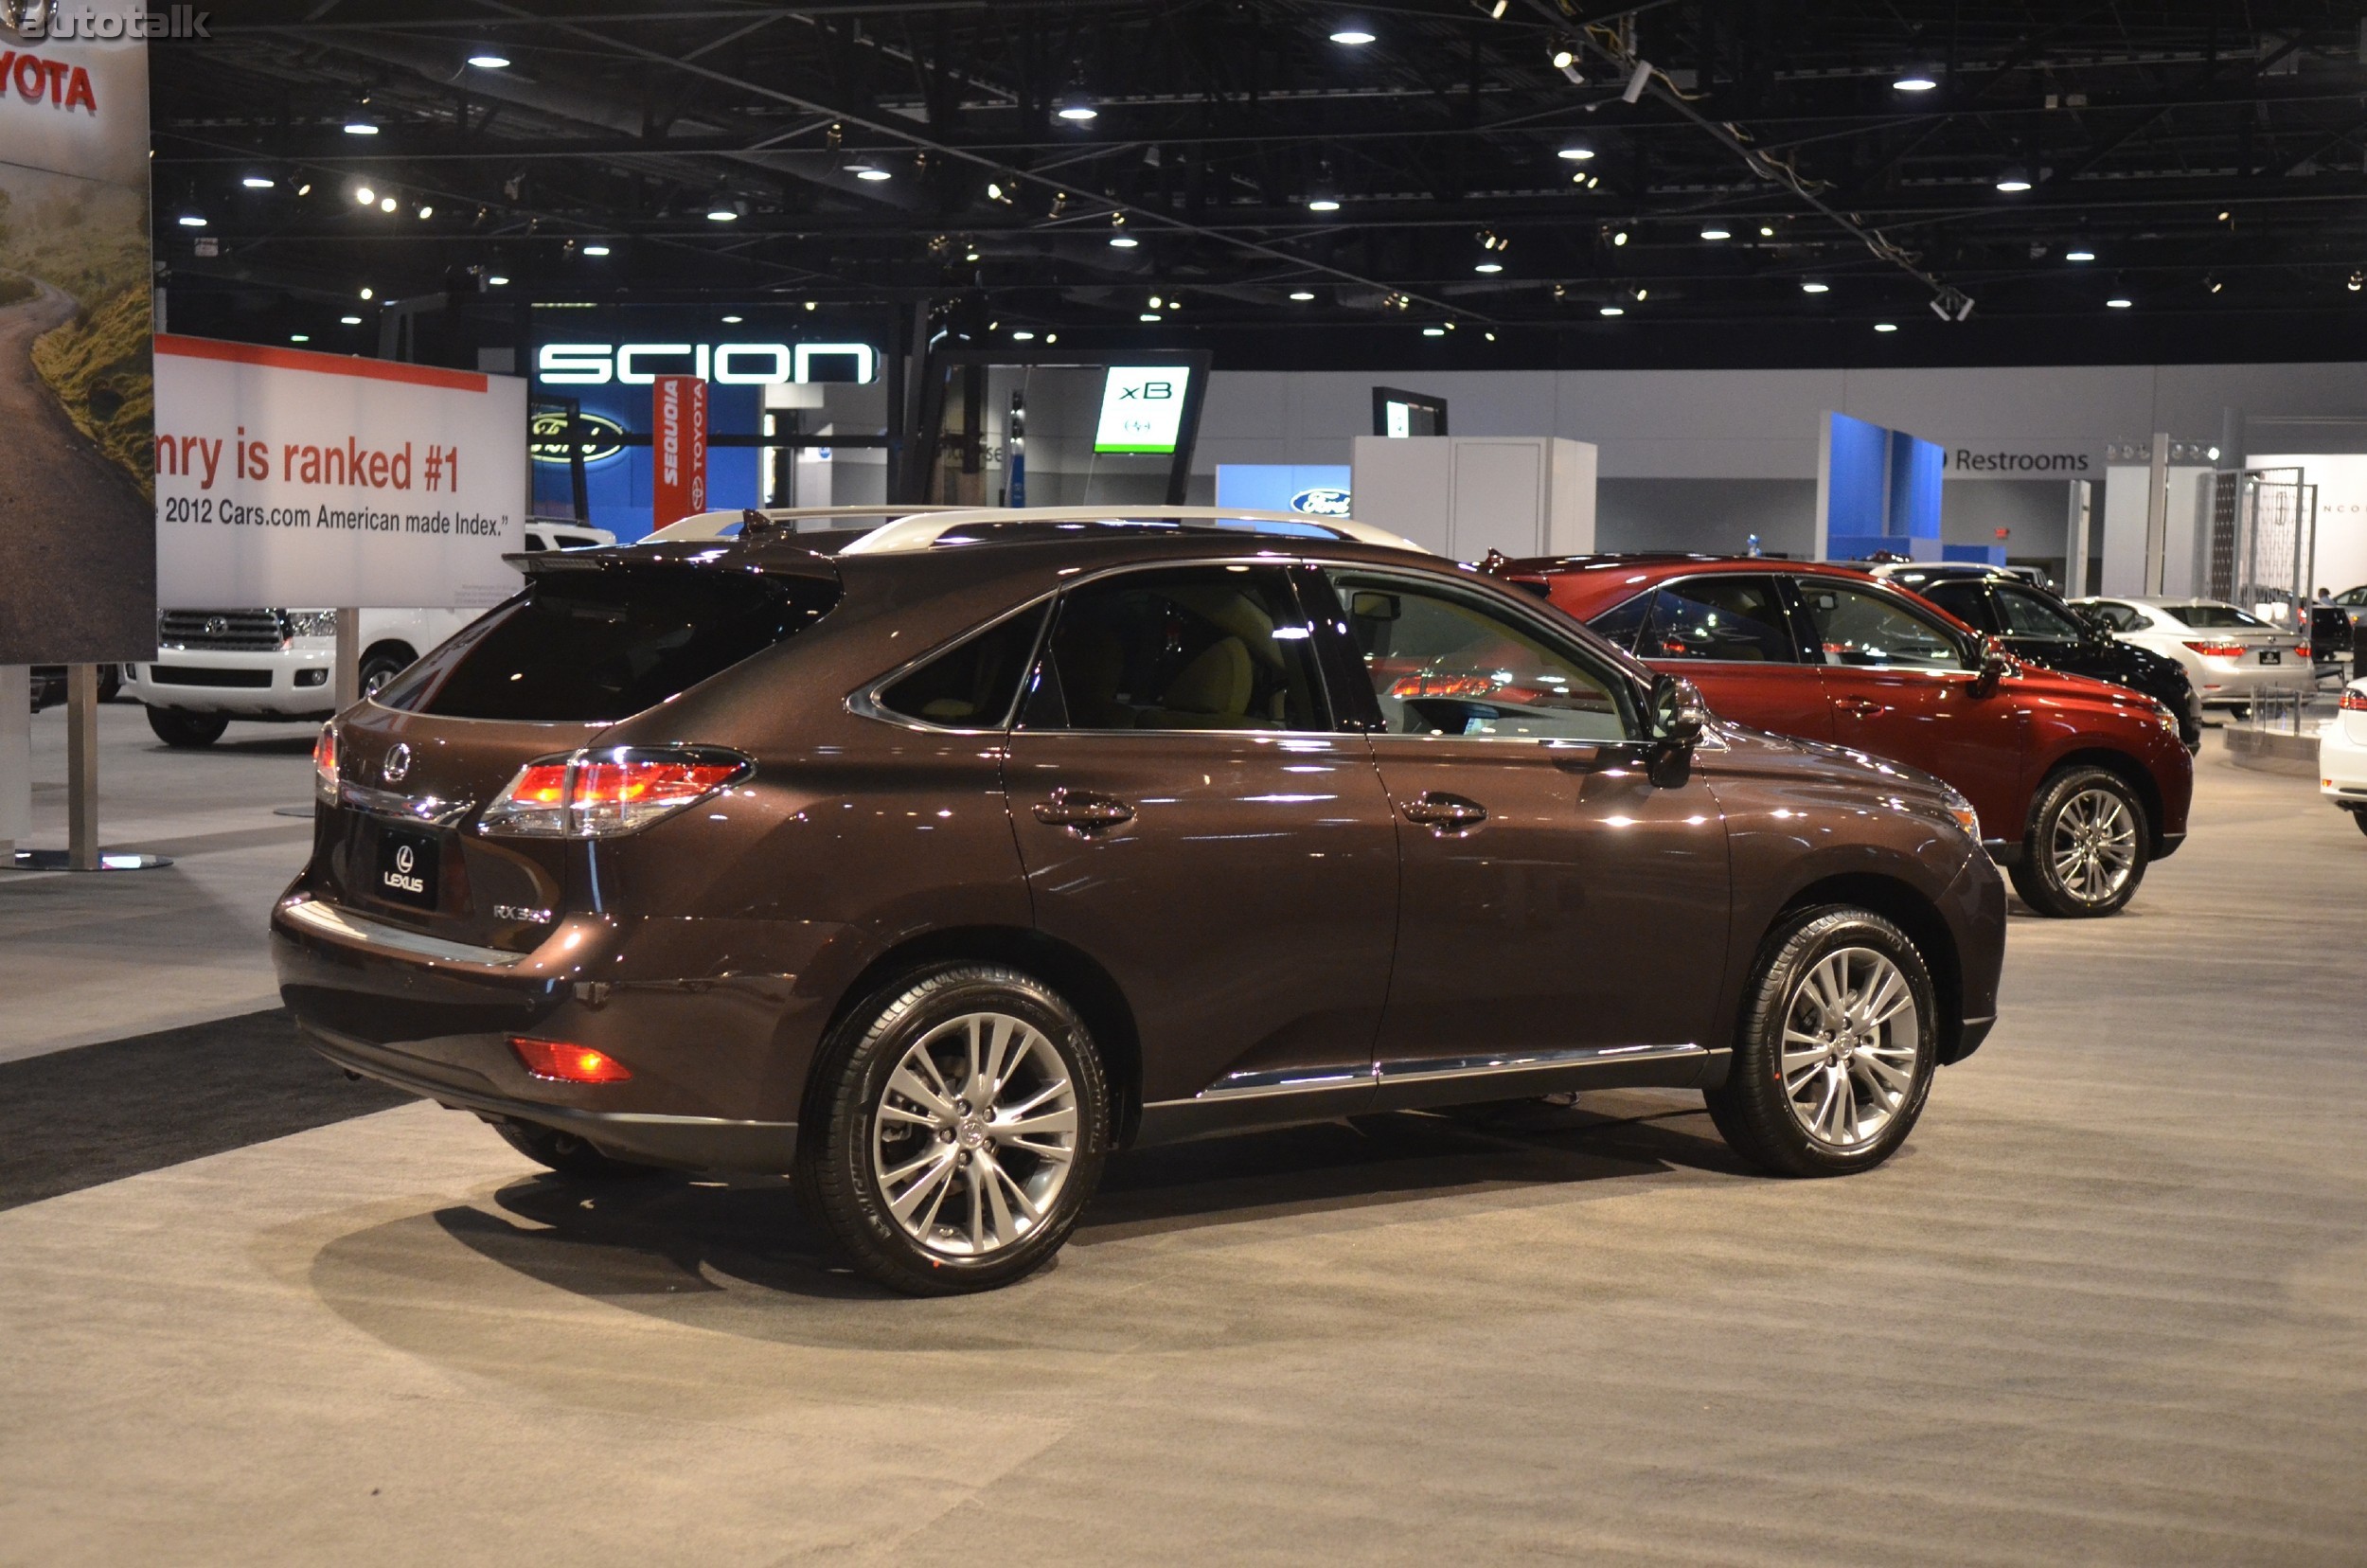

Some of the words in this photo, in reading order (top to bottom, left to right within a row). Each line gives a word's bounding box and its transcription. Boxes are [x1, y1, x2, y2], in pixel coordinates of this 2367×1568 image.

[1119, 383, 1172, 400] xB
[665, 381, 678, 486] SEQUOIA
[694, 383, 703, 472] TOYOTA
[238, 426, 269, 481] is
[284, 436, 411, 490] ranked
[425, 445, 457, 492] #1
[1956, 449, 2089, 471] Restrooms
[166, 497, 212, 523] 2012
[220, 499, 311, 527] Cars.com
[316, 504, 400, 531] American
[405, 511, 450, 534] made
[384, 871, 423, 893] LEXUS
